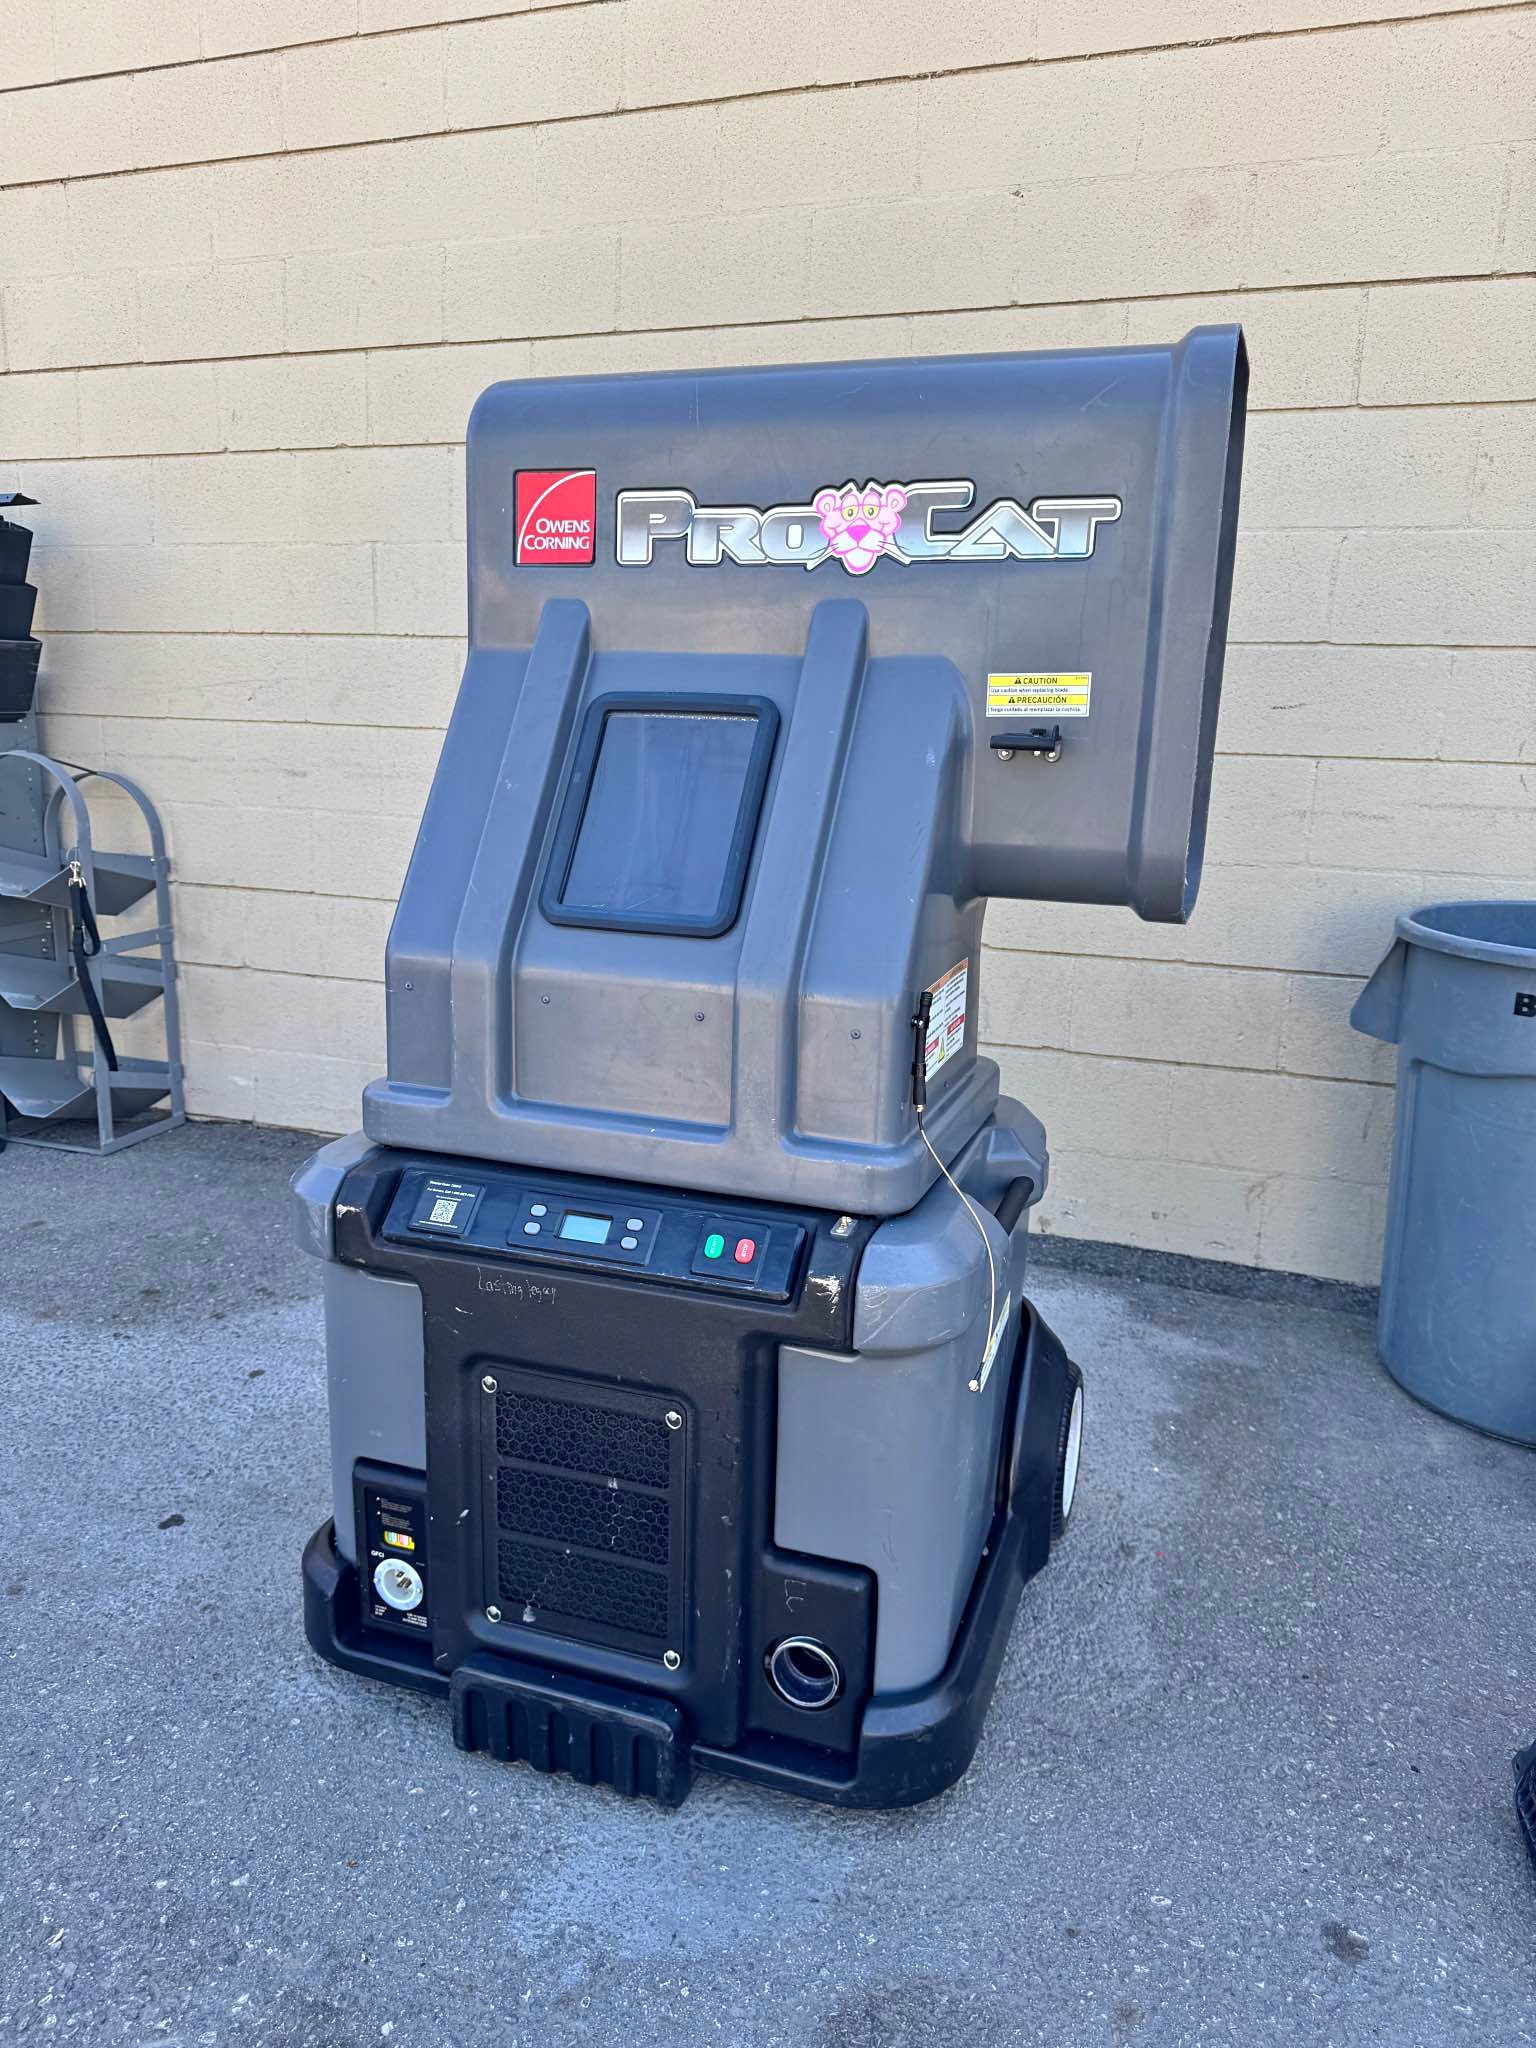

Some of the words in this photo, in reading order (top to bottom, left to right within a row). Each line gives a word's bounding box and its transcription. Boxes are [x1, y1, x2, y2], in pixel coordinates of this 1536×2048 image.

[536, 518, 590, 533] OWENS
[524, 535, 590, 550] CORNING
[1023, 677, 1058, 685] CAUTION
[1017, 695, 1067, 704] PRECAUCIÓN
